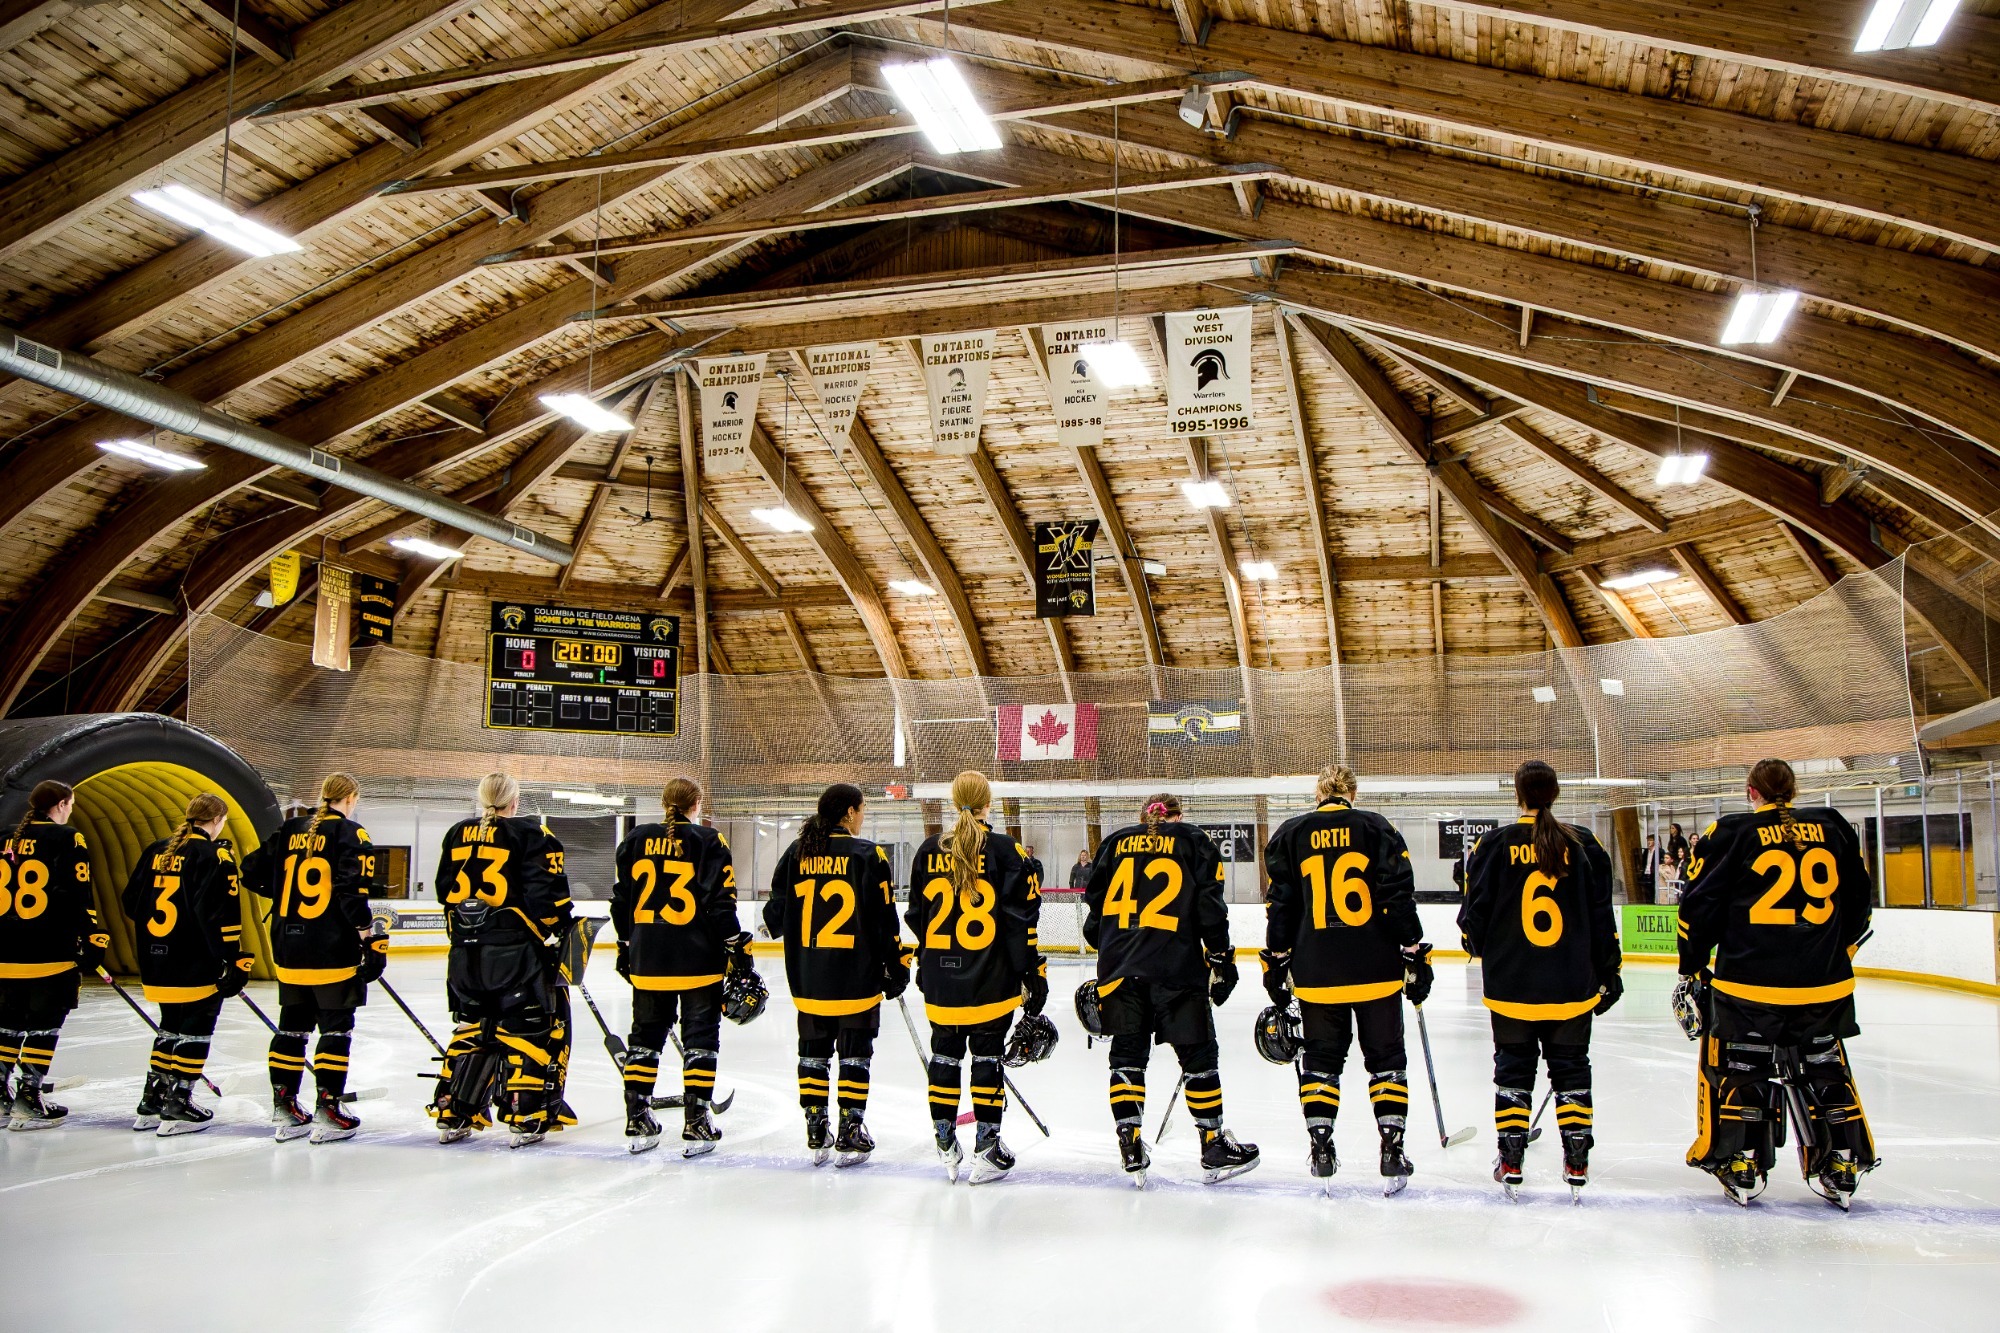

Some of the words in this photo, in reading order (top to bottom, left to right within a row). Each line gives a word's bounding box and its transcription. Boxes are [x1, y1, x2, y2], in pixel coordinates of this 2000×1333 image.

[1197, 313, 1220, 321] OUA
[1056, 328, 1106, 342] ONTARIO
[1193, 324, 1223, 333] WEST
[934, 339, 983, 352] ONTARIO
[1185, 335, 1232, 345] DIVISION
[813, 350, 871, 363] NATIONAL
[927, 351, 990, 365] CHAMPIONS
[709, 362, 755, 374] ONTARIO
[812, 362, 871, 376] CHAMPIONS
[703, 373, 760, 387] CHAMPIONS
[824, 380, 858, 390] WARRIOR
[825, 395, 856, 404] HOCKEY
[942, 394, 972, 404] ATHENA
[1064, 395, 1097, 404] HOCKEY
[942, 406, 971, 415] FIGURE
[1178, 404, 1242, 415] CHAMPIONS
[712, 419, 743, 428] WARRIOR
[940, 418, 974, 427] SKATING
[1060, 418, 1101, 428] 1995-96
[1171, 417, 1248, 432] 1995-1996
[712, 432, 742, 442] HOCKEY
[708, 447, 744, 457] 1973-74
[534, 608, 574, 617] COLUMBIA
[592, 612, 614, 620] FIELD
[615, 614, 641, 622] ARENA
[535, 616, 561, 624] HOME
[577, 618, 594, 627] THE
[596, 620, 641, 630] WARRIORS
[506, 638, 536, 649] HOME
[522, 650, 535, 669] 0
[558, 643, 616, 663] 20:00
[634, 647, 670, 658] VISITOR
[654, 660, 665, 678] 0
[526, 684, 553, 692] PENALTY
[648, 691, 674, 699] PENALTY
[1205, 829, 1248, 838] SECTION
[1445, 824, 1492, 835] SECTION
[1311, 827, 1350, 849] ORTH
[1115, 834, 1175, 857] ACHESON
[1220, 839, 1232, 858] 6
[358, 855, 375, 878] 19
[546, 851, 564, 874] 33
[800, 856, 849, 875] MURRAY
[75, 861, 90, 882] 8
[446, 845, 510, 907] 33
[723, 865, 736, 888] 2
[227, 874, 238, 896] 3
[280, 854, 331, 919] 19
[1300, 852, 1372, 930] 16
[1749, 847, 1838, 925] 29
[631, 859, 696, 926] 23
[879, 880, 896, 905] 1
[1102, 857, 1183, 932] 42
[147, 875, 181, 937] 3
[1521, 870, 1563, 947] 6
[794, 879, 855, 949] 12
[923, 878, 996, 950] 28
[1637, 915, 1672, 932] MEAL
[745, 995, 756, 1006] 23
